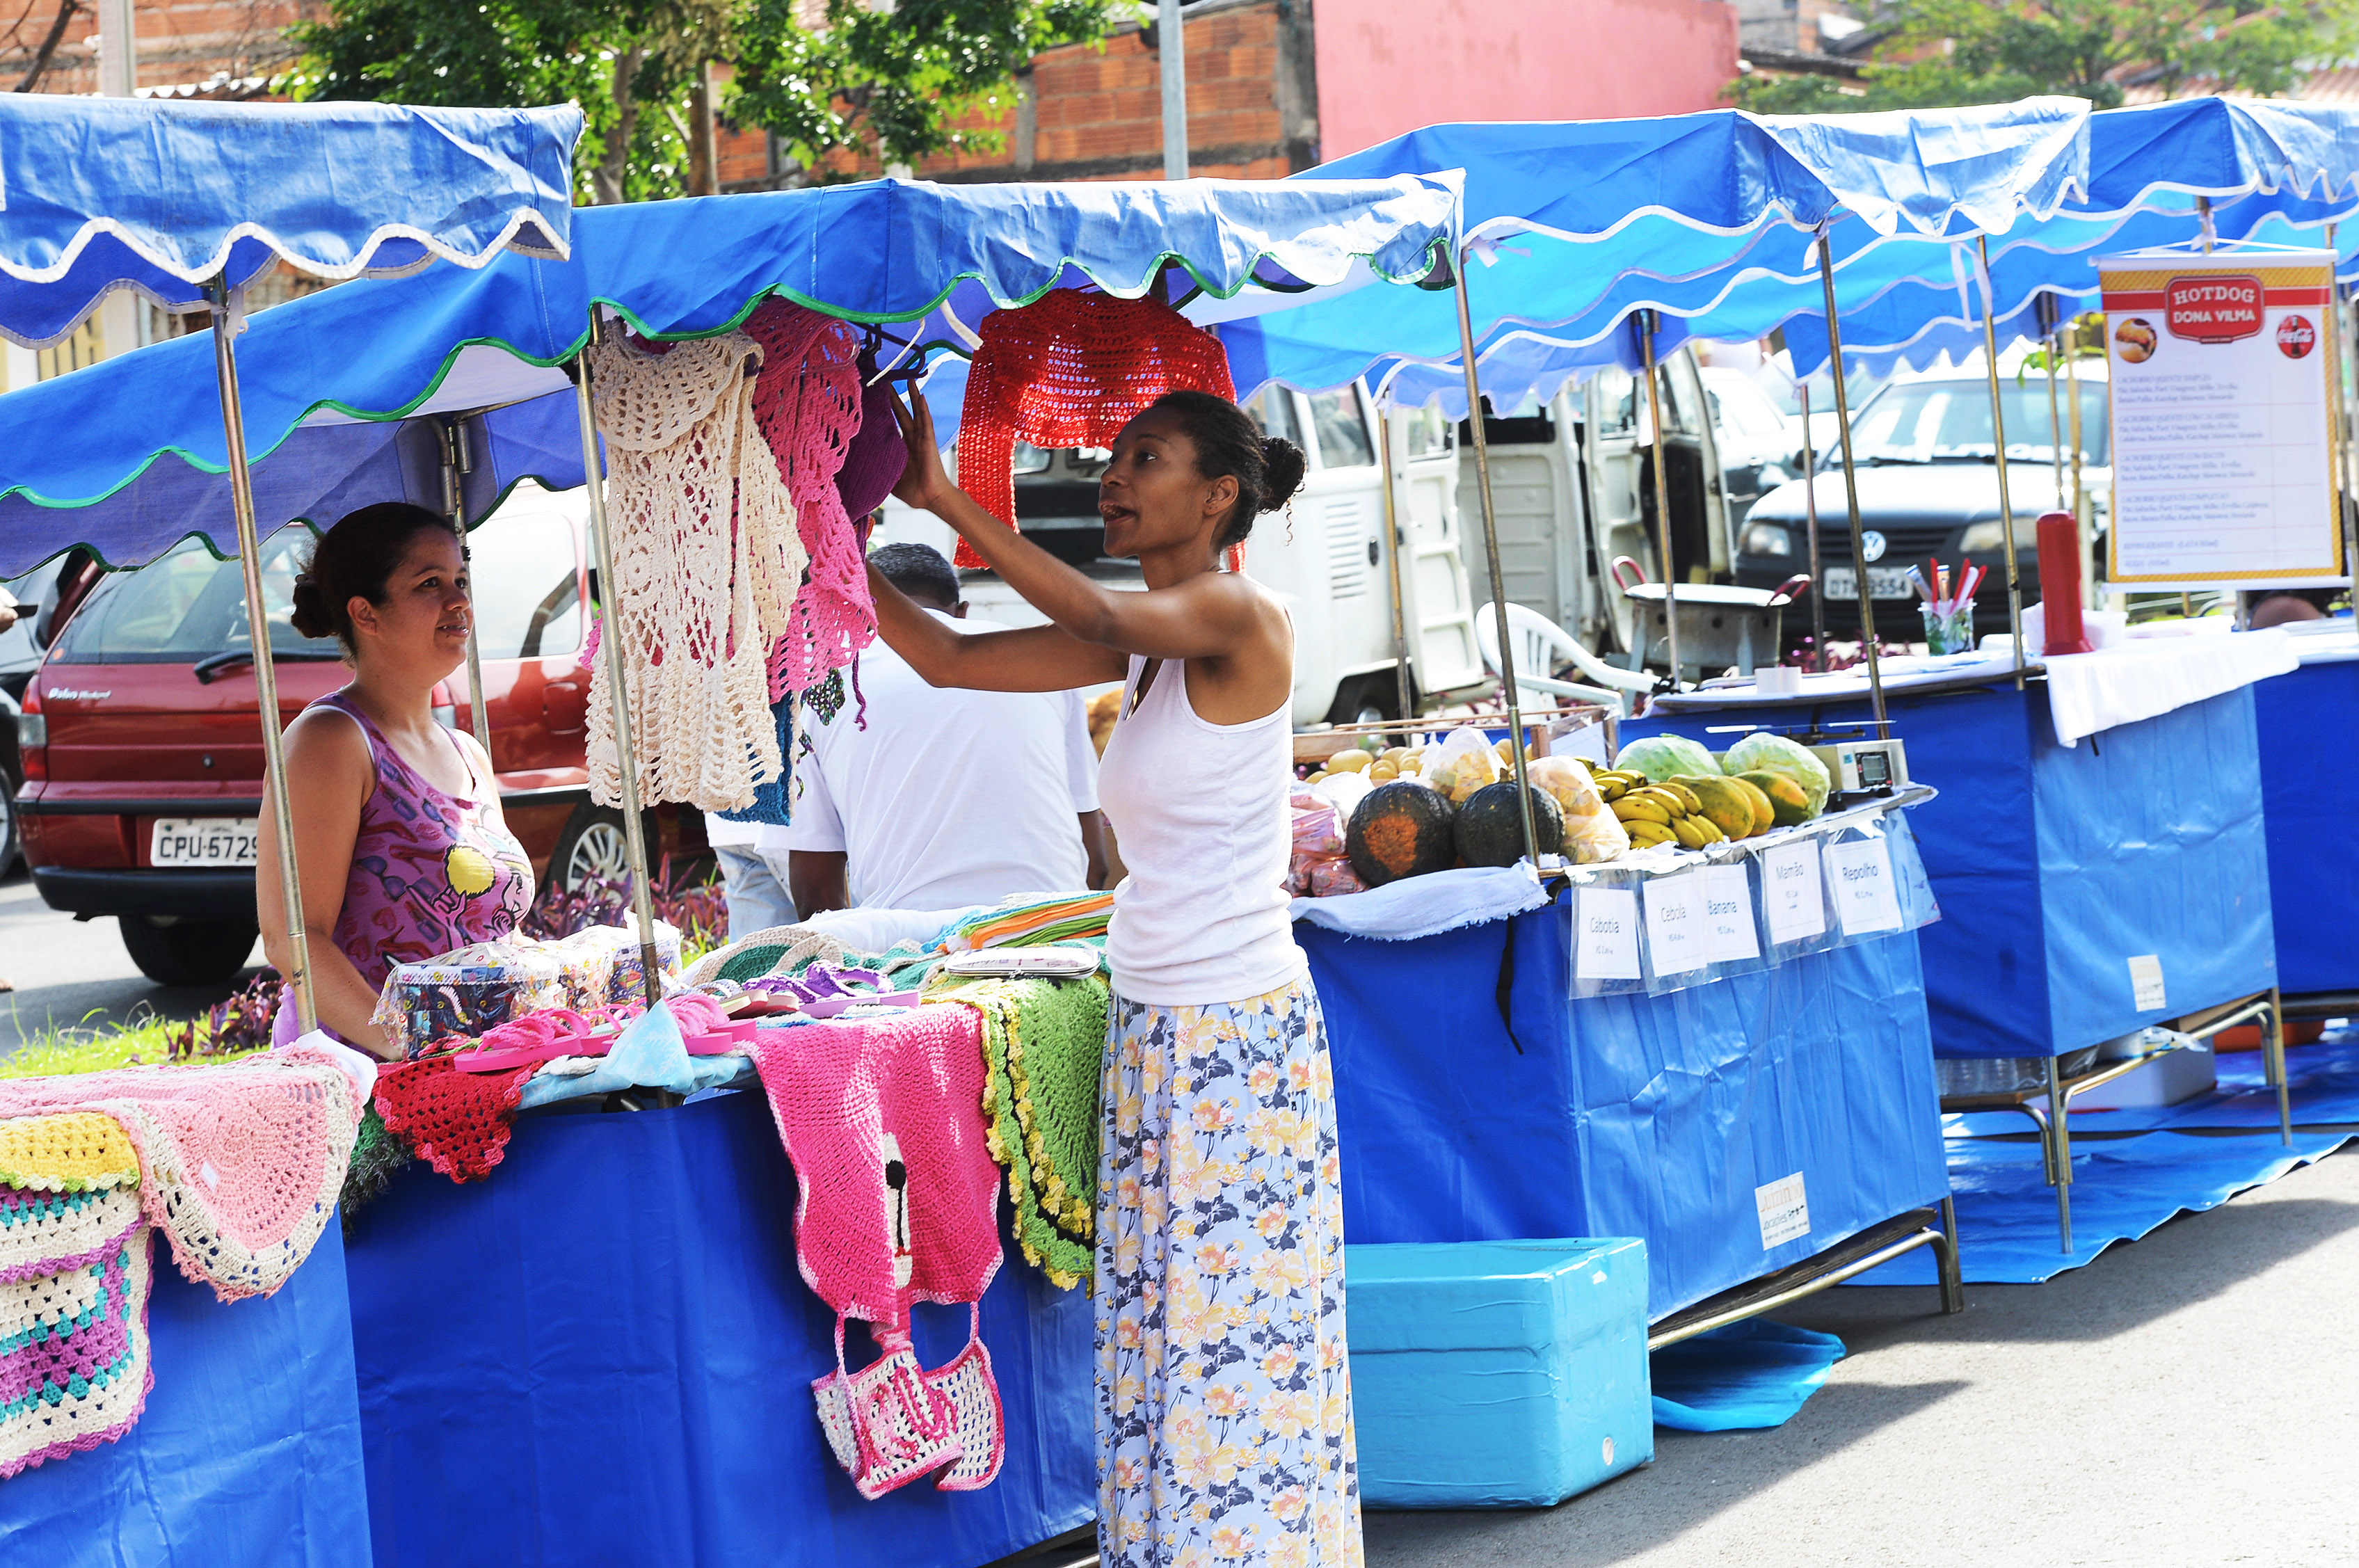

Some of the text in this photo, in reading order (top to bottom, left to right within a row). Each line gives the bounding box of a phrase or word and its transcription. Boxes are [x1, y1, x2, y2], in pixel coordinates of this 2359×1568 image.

[2173, 286, 2255, 305] HOTDOG
[2173, 309, 2256, 324] DONA VILMA
[1843, 863, 1878, 883] Repolho
[1661, 906, 1686, 922] Cebola
[1708, 900, 1737, 915] Banana
